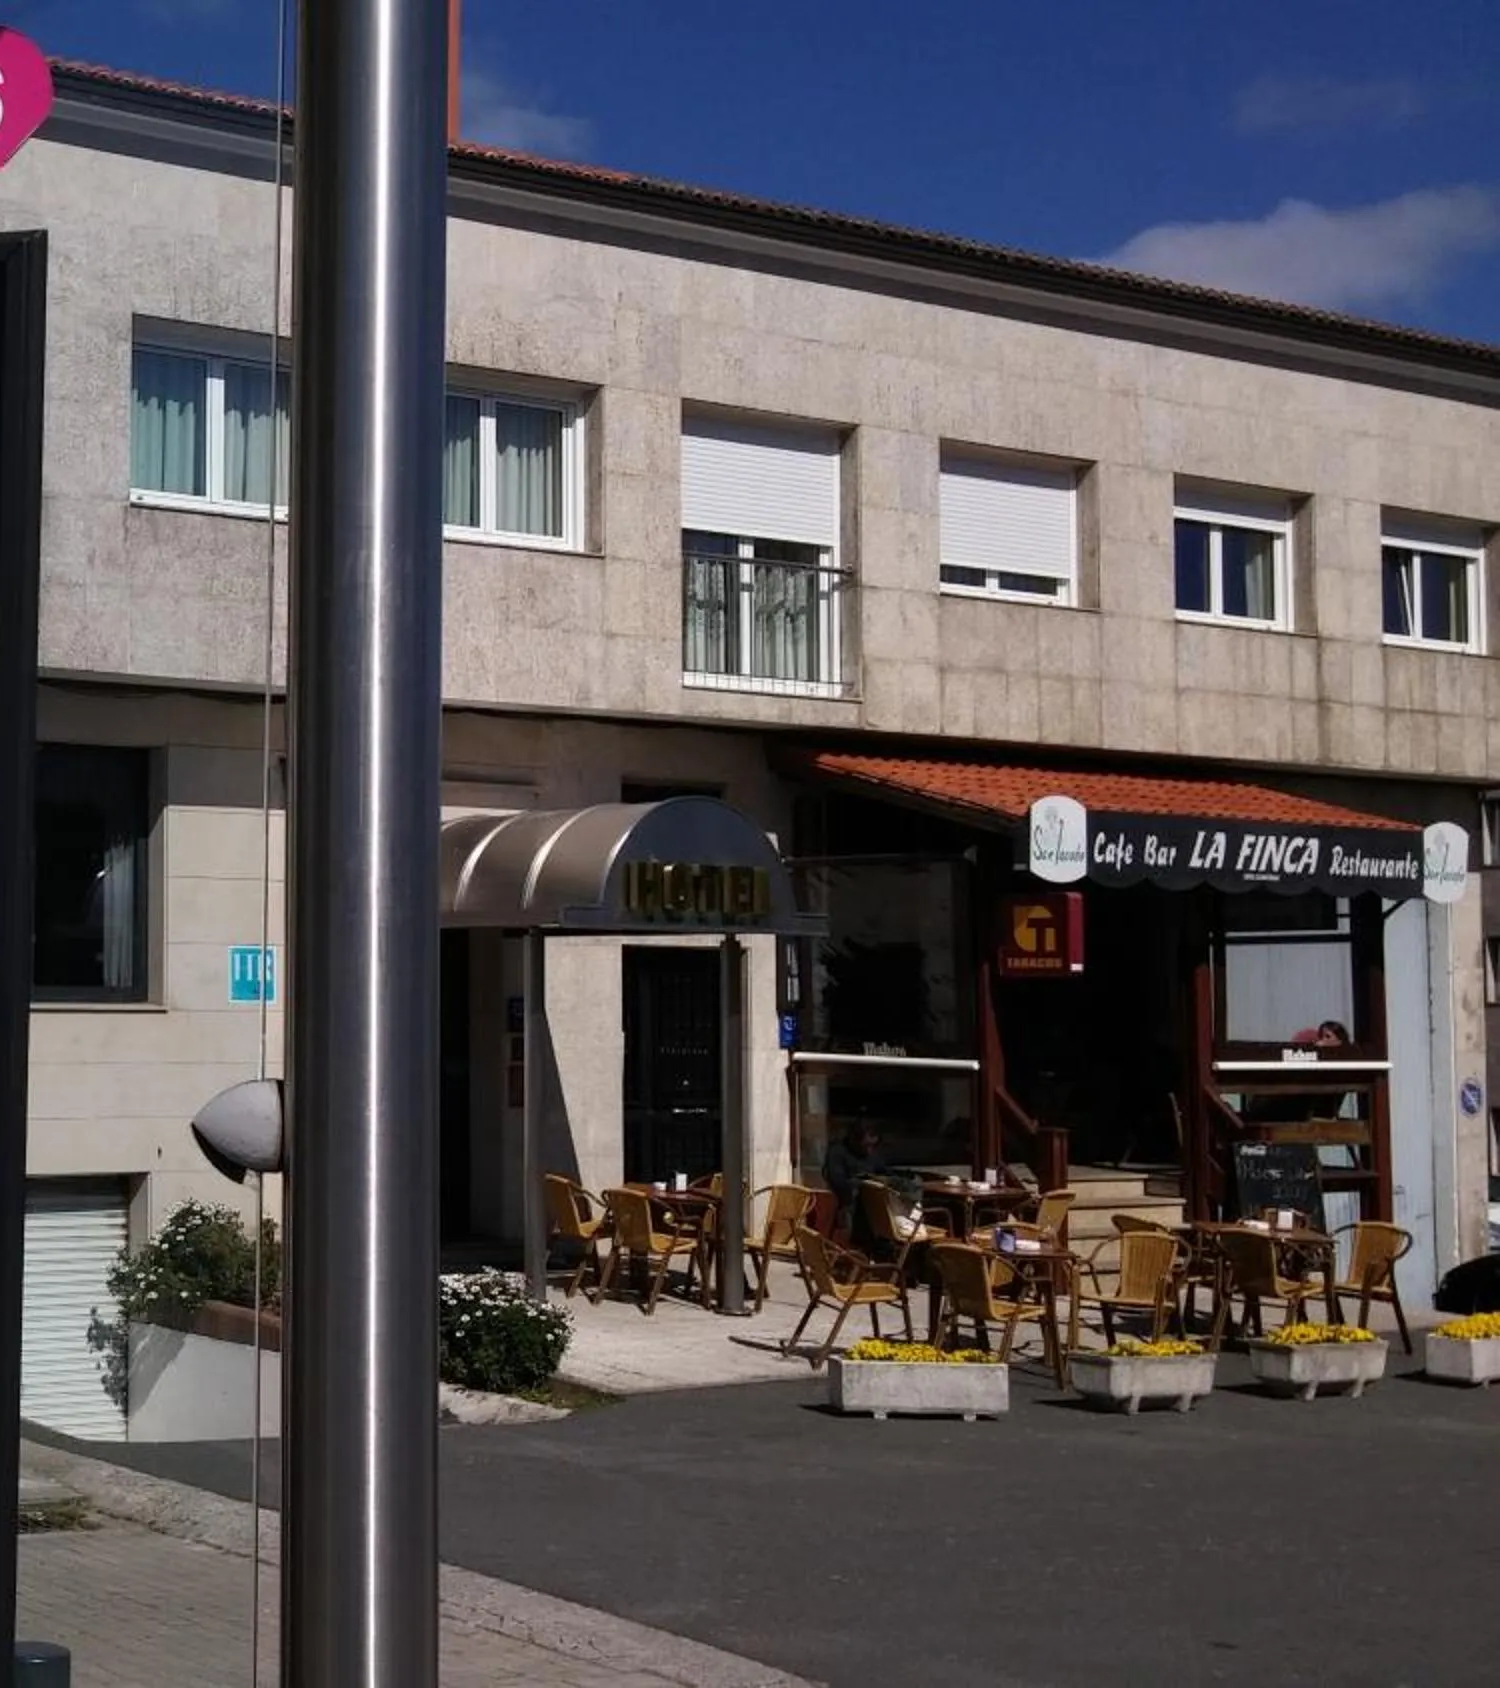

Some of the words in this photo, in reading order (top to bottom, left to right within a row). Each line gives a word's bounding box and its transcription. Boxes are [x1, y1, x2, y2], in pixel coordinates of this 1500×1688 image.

[1093, 831, 1134, 872] Cafe
[1144, 834, 1177, 866] Bar
[1189, 831, 1227, 870] LA
[1235, 834, 1320, 875] FINCA
[1329, 845, 1419, 880] Restaurante
[623, 861, 771, 917] HOTEL
